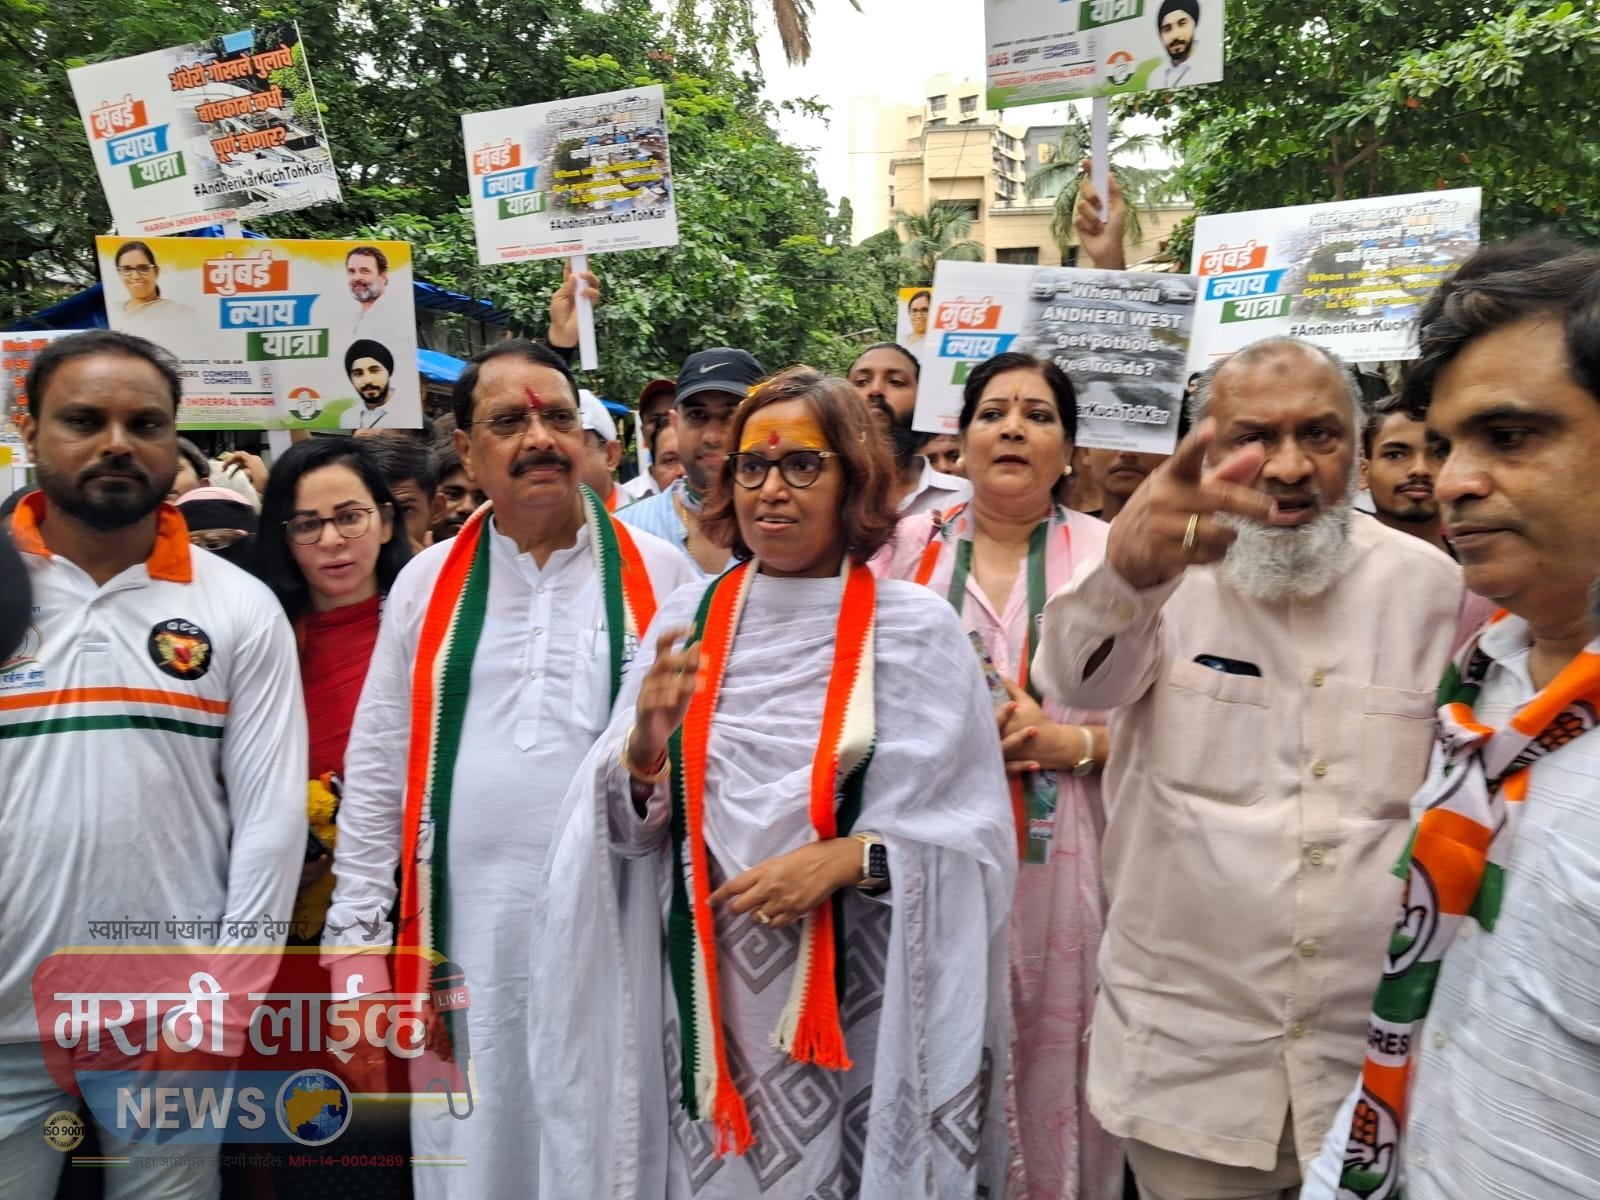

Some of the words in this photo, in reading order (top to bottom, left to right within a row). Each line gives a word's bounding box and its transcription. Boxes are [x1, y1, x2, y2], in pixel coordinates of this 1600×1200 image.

[169, 62, 208, 91] अंधेरी
[207, 53, 253, 82] गोखले
[252, 44, 293, 79] पुलाचे
[93, 94, 135, 137] मुंबई
[195, 98, 253, 123] बांधकाम
[252, 84, 283, 111] कधी
[109, 132, 158, 159] न्याय
[210, 131, 238, 163] पूर्ण
[237, 126, 287, 153] होणार?
[476, 138, 512, 175] मुंबई
[138, 154, 180, 182] यात्रा
[194, 164, 325, 197] #AndherikarKuchTohKar
[487, 172, 527, 195] न्याय
[506, 193, 541, 214] यात्रा
[550, 209, 667, 231] #AndherikarKuchTohKar
[1204, 239, 1257, 276] मुंबई
[208, 249, 272, 296] मुंबई
[1213, 274, 1269, 298] न्याय
[1071, 282, 1122, 300] When
[1126, 287, 1160, 302] will
[227, 299, 297, 327] न्याय
[940, 296, 993, 331] मुंबई
[1041, 306, 1127, 325] ANDHERI
[1128, 311, 1184, 329] WEST
[1234, 296, 1284, 319] यात्रा
[260, 330, 322, 357] यात्रा
[946, 336, 1001, 358] न्याय
[1056, 333, 1088, 349] get
[1089, 334, 1161, 352] pothole
[203, 377, 252, 385] COMMITTEE
[1095, 360, 1156, 376] roads?
[185, 397, 238, 406] INDERPAL
[240, 397, 276, 406] SINGH
